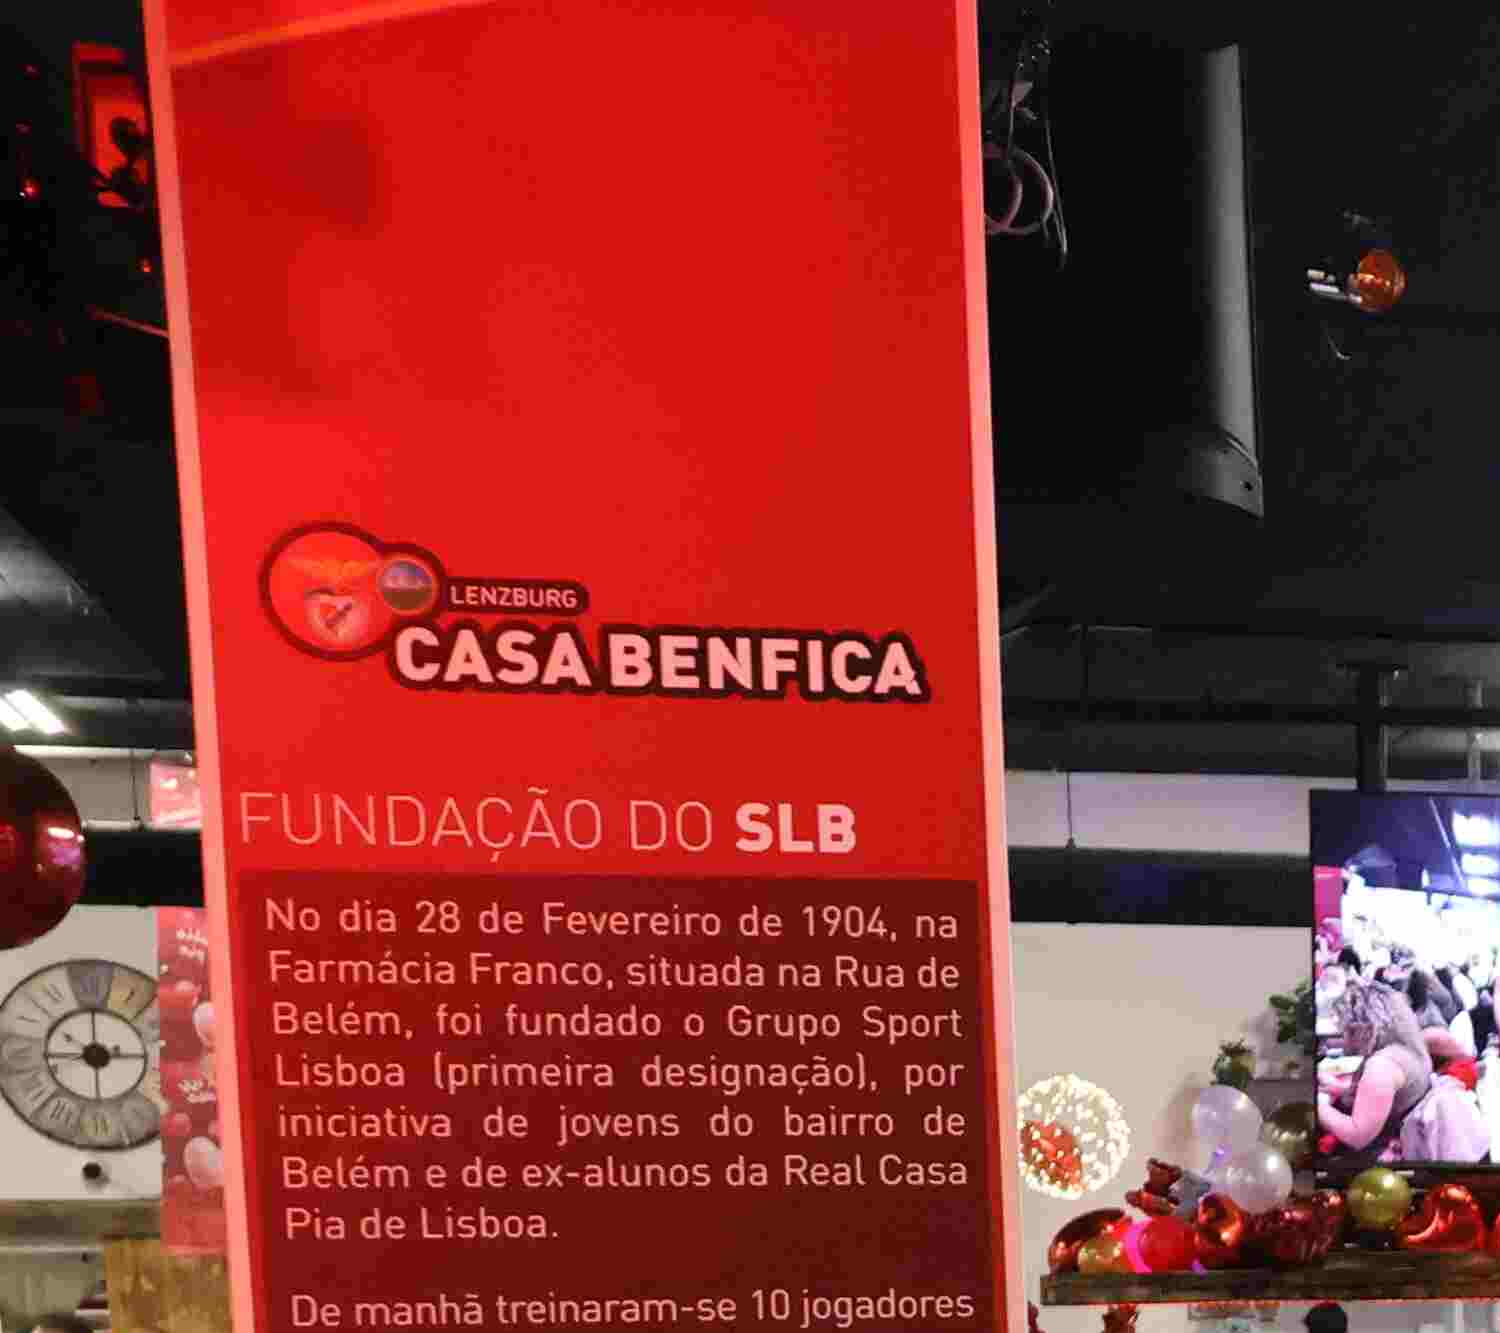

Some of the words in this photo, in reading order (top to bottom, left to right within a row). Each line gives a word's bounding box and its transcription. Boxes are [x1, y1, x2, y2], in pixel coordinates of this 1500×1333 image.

[451, 586, 577, 608] LENZBURG
[397, 627, 591, 686] CASA
[609, 634, 921, 694] BENFICA
[240, 787, 601, 862] FUNDAÇÃO
[630, 800, 712, 851] DO
[736, 803, 856, 853] SLB
[266, 898, 320, 931] No
[340, 900, 396, 932] dia
[416, 901, 460, 933] 28
[480, 902, 523, 934] de
[544, 902, 720, 936] Fevereiro
[739, 905, 782, 936] de
[803, 906, 896, 941] 1904,
[917, 916, 956, 938] na
[269, 950, 455, 984] Farmácia
[470, 952, 613, 990] Franco,
[627, 954, 764, 986] situada
[779, 965, 820, 986] na
[836, 956, 904, 987] Rua
[918, 957, 959, 988] de
[273, 1002, 412, 1040] Belém,
[436, 1004, 481, 1035] foi
[505, 1004, 661, 1035] fundado
[685, 1014, 704, 1036] o
[728, 1005, 840, 1045] Grupo
[863, 1006, 962, 1044] Sport
[276, 1053, 404, 1086] Lisboa
[435, 1051, 613, 1094] (primeira
[642, 1053, 876, 1095] designação),
[905, 1064, 964, 1095] por
[280, 1105, 451, 1137] iniciativa
[484, 1106, 528, 1137] de
[557, 1105, 679, 1146] jovens
[710, 1105, 752, 1136] do
[785, 1106, 893, 1136] bairro
[924, 1105, 964, 1136] de
[283, 1155, 408, 1189] Belém
[426, 1165, 446, 1188] e
[462, 1156, 506, 1187] de
[523, 1156, 710, 1187] ex-alunos
[726, 1155, 767, 1186] da
[785, 1155, 866, 1185] Real
[880, 1154, 966, 1184] Casa
[286, 1208, 344, 1239] Pia
[361, 1208, 405, 1239] de
[421, 1207, 557, 1238] Lisboa.
[292, 1295, 340, 1326] De
[355, 1294, 483, 1325] manhã
[496, 1292, 736, 1323] treinaram-se
[752, 1289, 789, 1320] 10
[800, 1288, 974, 1328] jogadores
